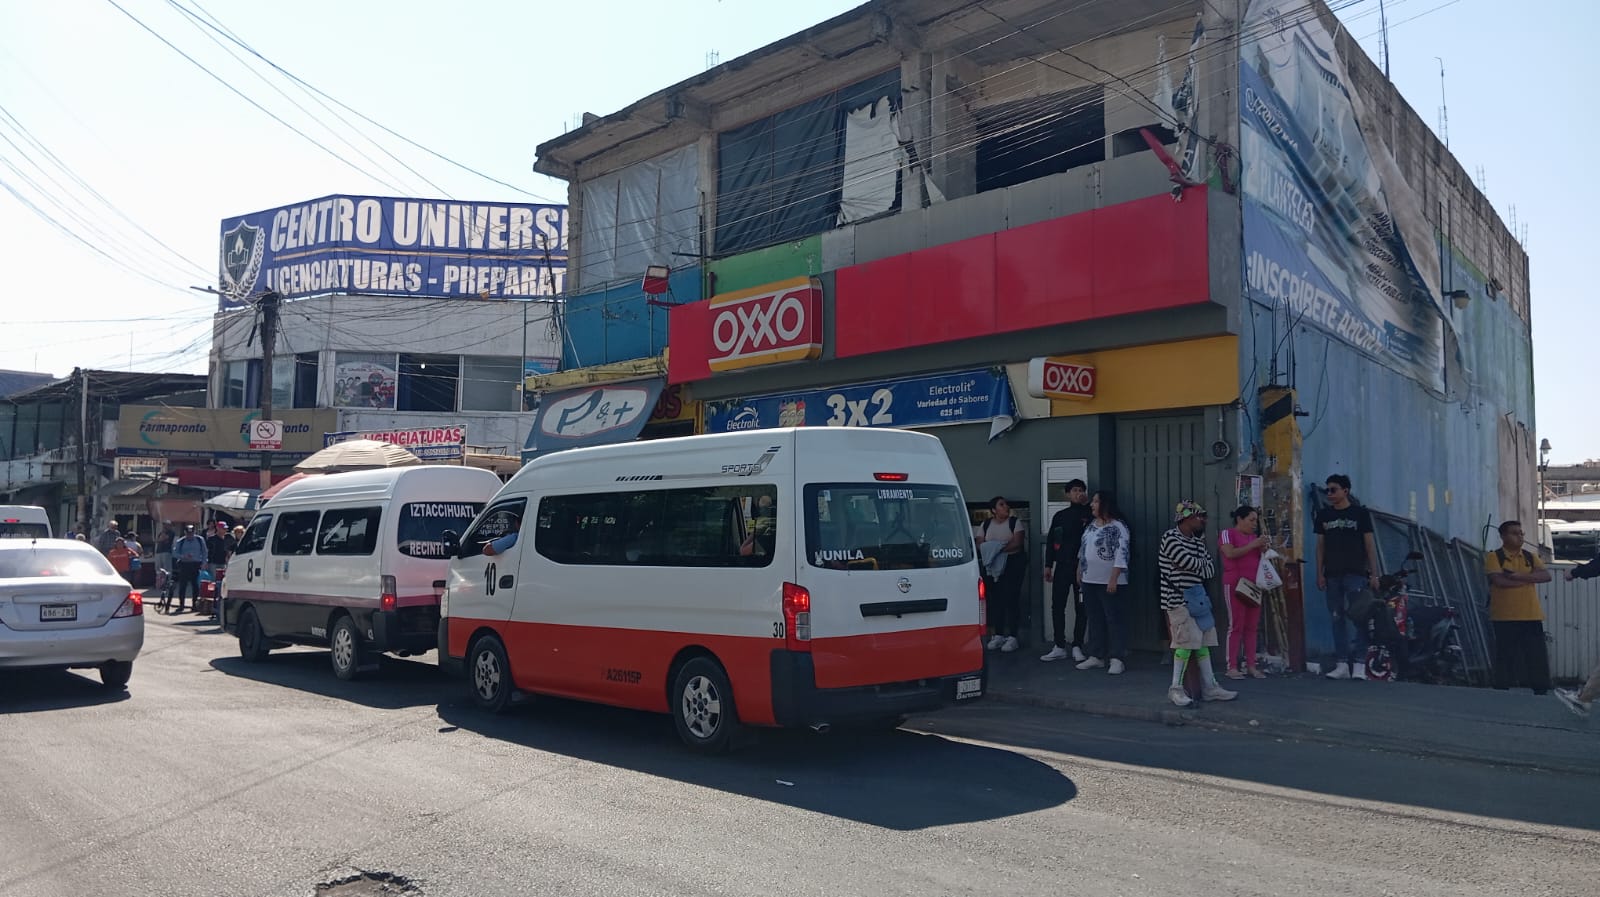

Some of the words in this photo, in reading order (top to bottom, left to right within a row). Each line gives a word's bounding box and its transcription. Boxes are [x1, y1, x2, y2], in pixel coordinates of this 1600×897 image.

[270, 198, 383, 252] CENTRO
[267, 258, 422, 296] LICENCIATURAS
[713, 295, 805, 355] OXXO
[1047, 366, 1092, 392] OXXO
[826, 388, 893, 427] 3x2
[917, 397, 948, 409] Variedad
[958, 393, 989, 405] Sabores
[139, 420, 207, 436] Farmapronto
[877, 489, 914, 500] LIBRAMIENTO
[410, 503, 477, 518] IZTACCIHUATL
[932, 549, 964, 560] CONOS
[246, 558, 253, 583] 8
[484, 562, 497, 597] 10
[772, 621, 784, 638] 30
